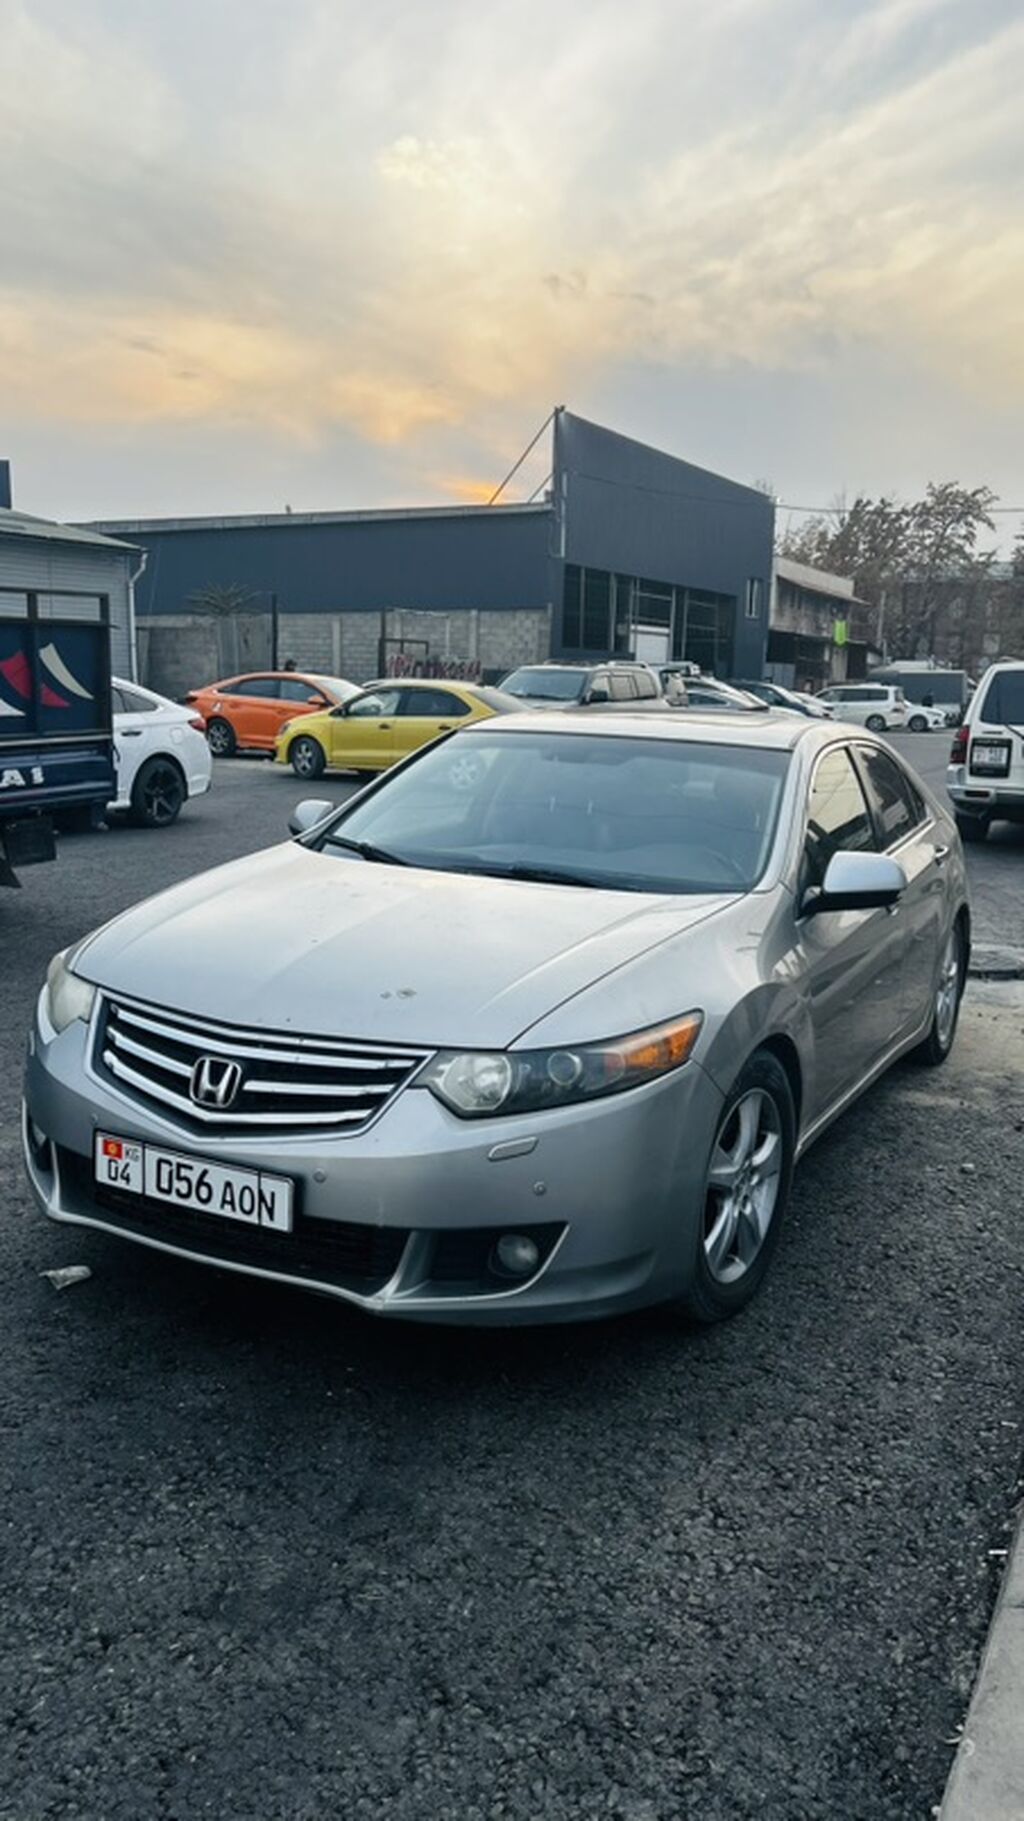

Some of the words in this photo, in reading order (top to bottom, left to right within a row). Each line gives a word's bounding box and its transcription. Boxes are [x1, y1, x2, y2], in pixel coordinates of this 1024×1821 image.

[124, 1146, 140, 1162] KG
[108, 1158, 130, 1186] 04
[156, 1158, 213, 1205] 056
[220, 1181, 275, 1222] AON
